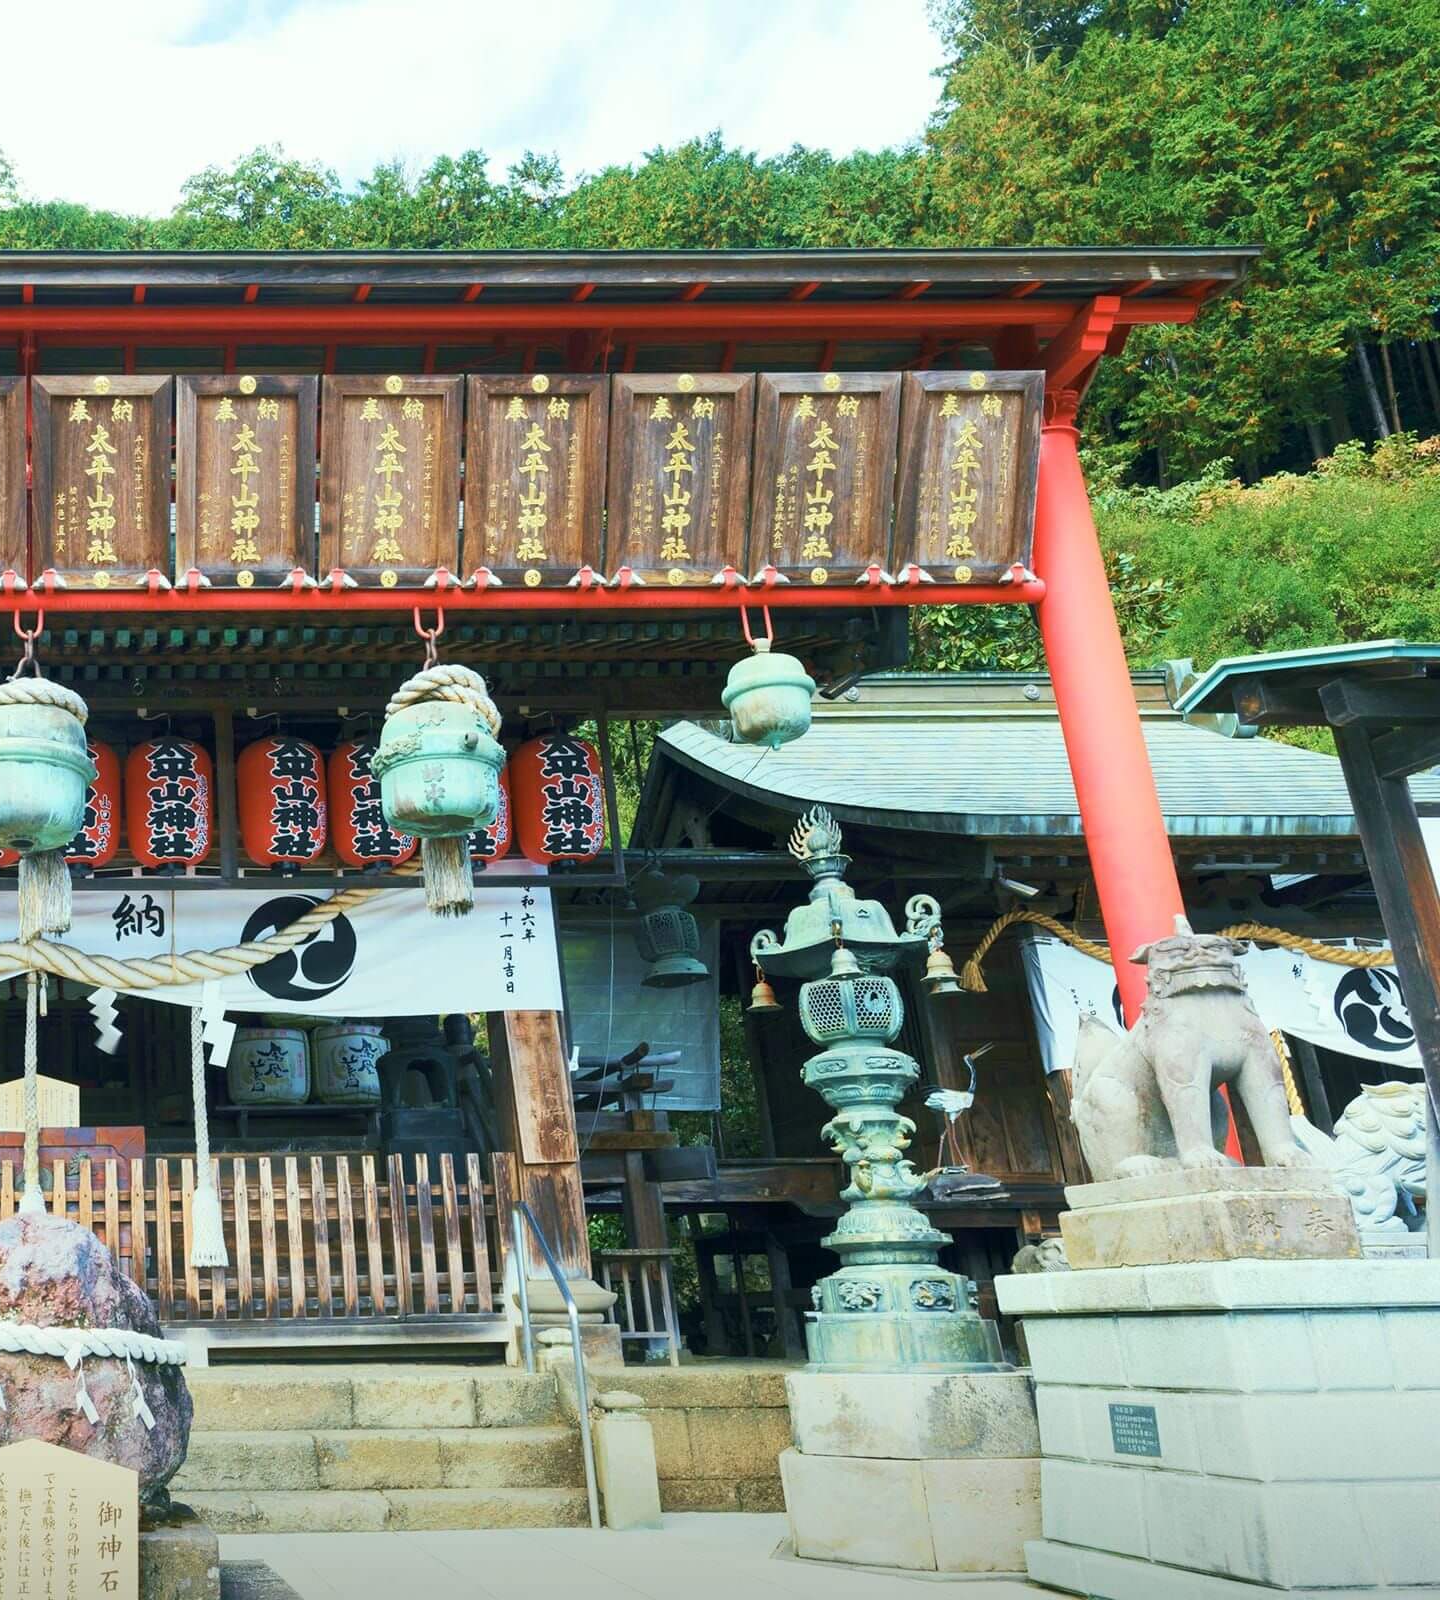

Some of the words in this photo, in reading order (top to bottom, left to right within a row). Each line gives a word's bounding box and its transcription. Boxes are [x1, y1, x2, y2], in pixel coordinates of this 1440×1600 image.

[70, 399, 133, 423] 奉納
[215, 398, 279, 422] 奉納
[360, 398, 424, 422] 奉納
[505, 397, 569, 421] 奉納
[650, 397, 715, 421] 奉納
[797, 396, 860, 418] 奉納
[939, 395, 1002, 417] 奉納
[86, 425, 118, 563] 太平山神社
[231, 424, 262, 562] 太平山神社
[374, 424, 406, 561] 太平山神社
[517, 423, 552, 560] 太平山神社
[661, 423, 695, 560] 太平山神社
[802, 421, 839, 559] 太平山神社
[946, 421, 983, 558] 太平山神社
[145, 743, 198, 859] 太平山神社
[266, 741, 319, 859] 太平山神社
[536, 740, 594, 855] 太平山神社
[499, 912, 515, 994] 十一月吉日
[17, 1488, 33, 1600] 撫でた後には正
[66, 1488, 81, 1600] こちらの神石を
[96, 1501, 122, 1593] 御神石
